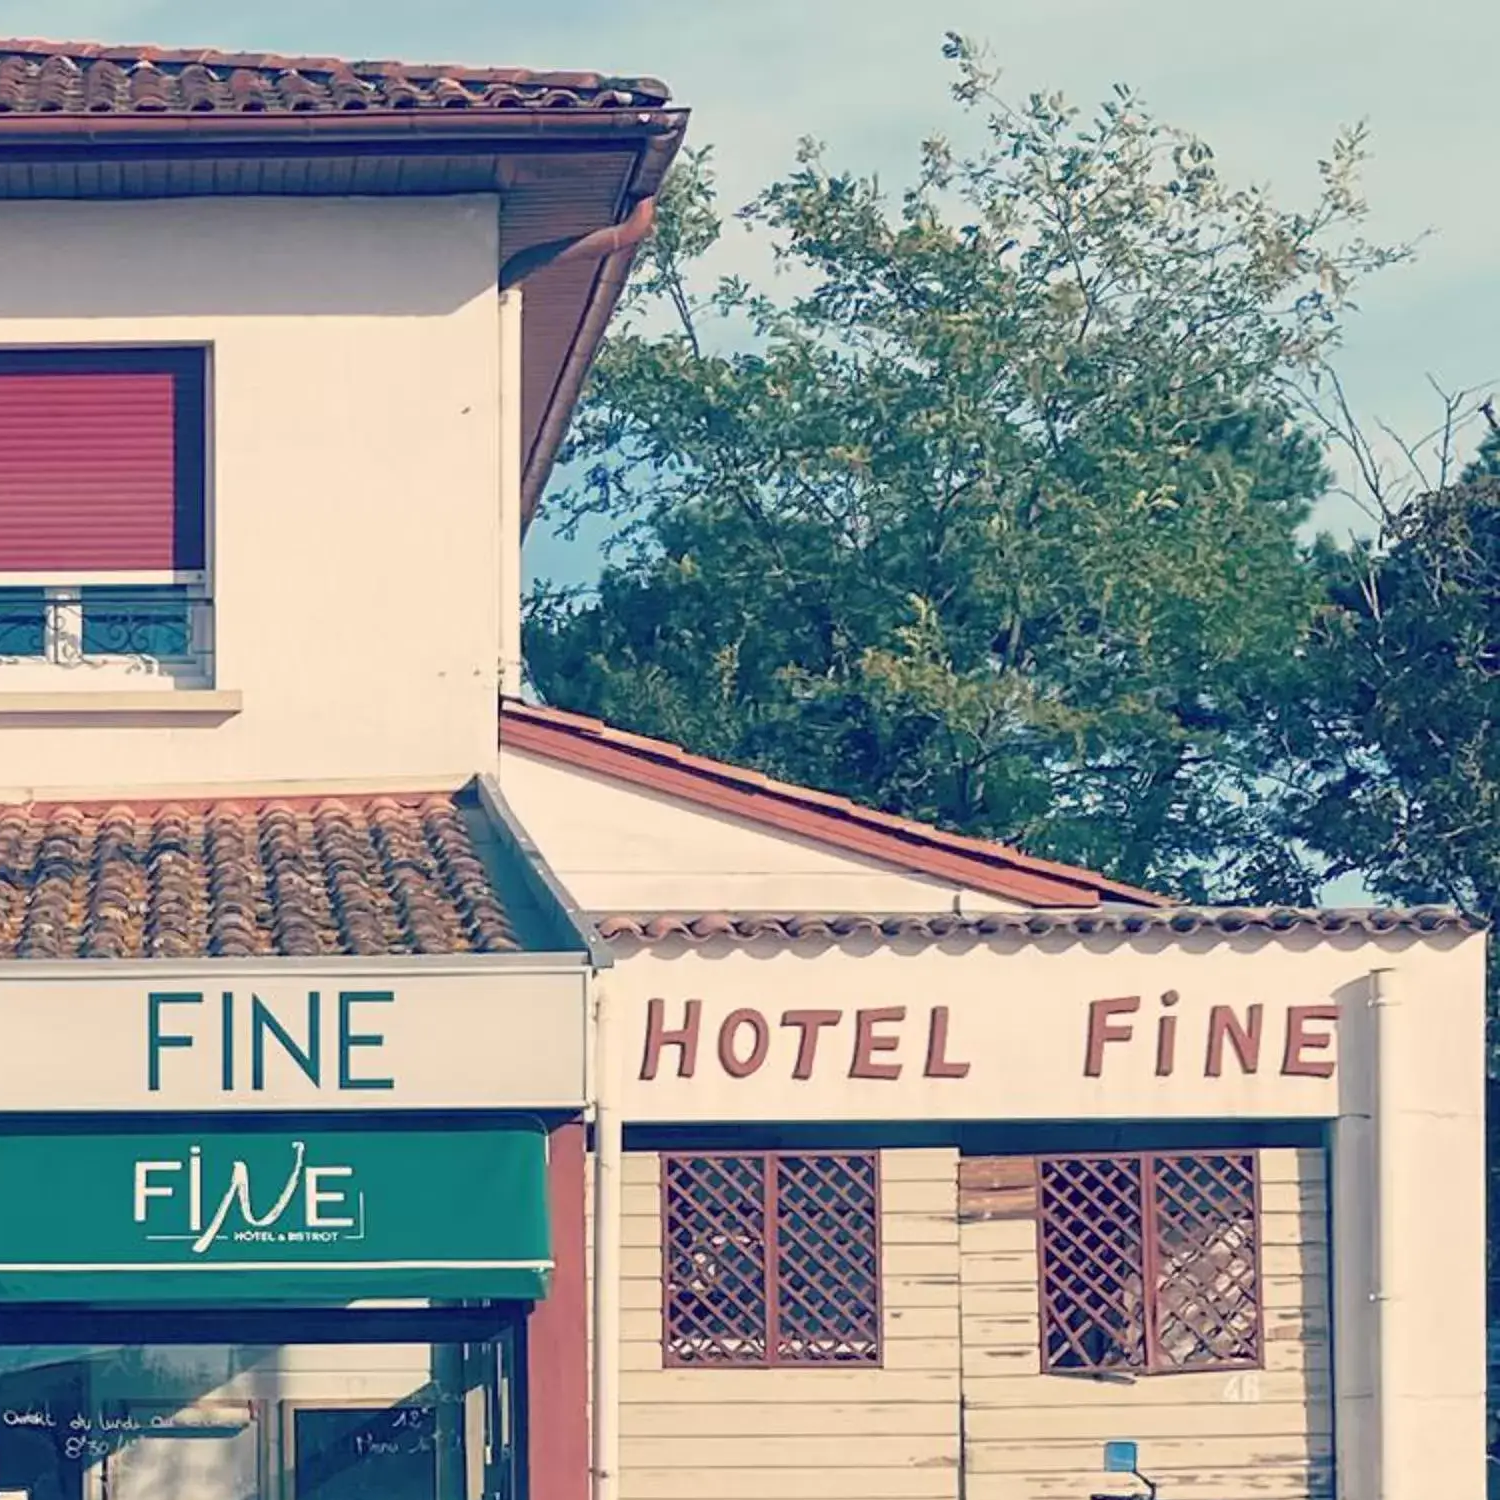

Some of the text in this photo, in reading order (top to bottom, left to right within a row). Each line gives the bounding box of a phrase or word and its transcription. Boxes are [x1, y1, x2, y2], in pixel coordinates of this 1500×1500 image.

[147, 990, 396, 1092] FINE
[638, 998, 971, 1081] HOTEL
[287, 1231, 339, 1243] BISTROT
